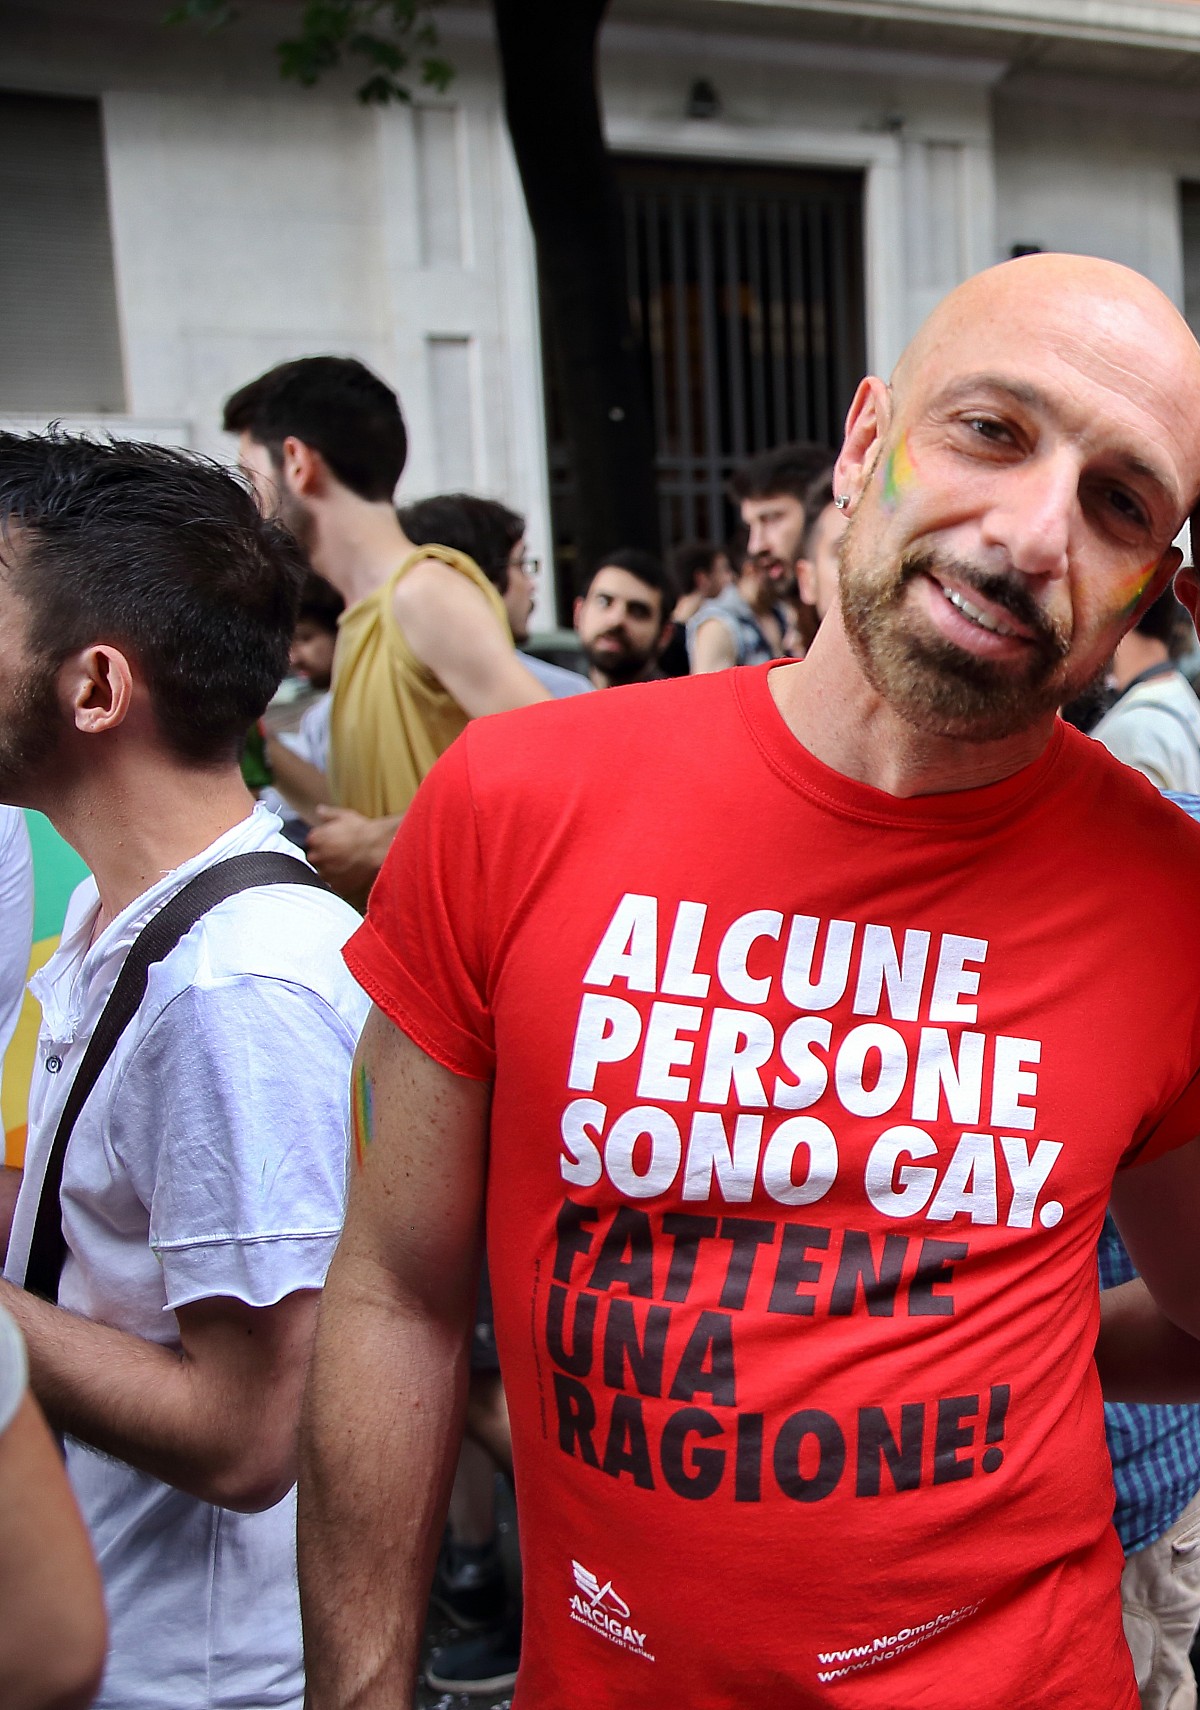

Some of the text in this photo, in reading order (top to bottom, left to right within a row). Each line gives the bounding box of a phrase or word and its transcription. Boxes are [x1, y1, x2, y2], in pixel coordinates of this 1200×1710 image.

[583, 893, 988, 1023] ALCUNE
[568, 993, 1042, 1131] PERSONE
[560, 1098, 1064, 1228] SONO GAY.
[552, 1197, 968, 1317] FATTENE
[546, 1285, 737, 1407] UNA
[551, 1371, 1011, 1503] RAGIONE!
[568, 1594, 647, 1647] ARCIGAY
